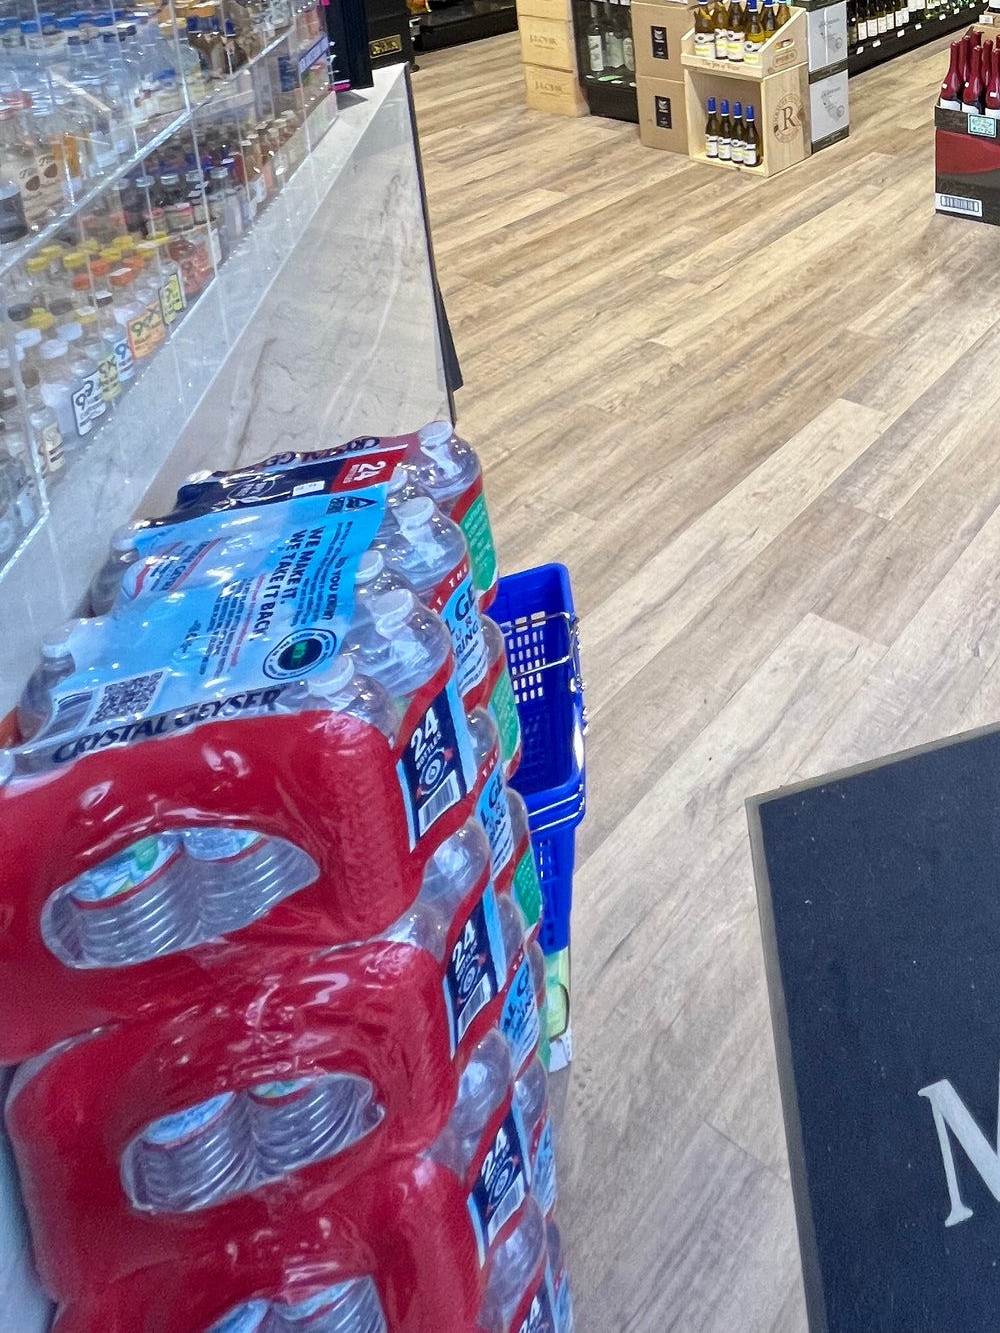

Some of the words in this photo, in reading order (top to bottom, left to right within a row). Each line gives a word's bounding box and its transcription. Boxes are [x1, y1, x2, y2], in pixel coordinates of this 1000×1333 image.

[353, 460, 386, 482] 24
[286, 529, 307, 551] WE
[304, 526, 326, 548] WE
[269, 552, 297, 583] TAKE
[287, 550, 316, 586] MAKE
[328, 572, 341, 591] YOU
[264, 585, 281, 598] IT
[280, 587, 298, 604] IT.
[175, 688, 288, 729] GEYSER
[52, 717, 170, 764] CRYSTAL
[411, 707, 440, 762] 24
[416, 730, 442, 771] BOTTLES
[452, 919, 477, 974] 24
[481, 1126, 509, 1193] 24
